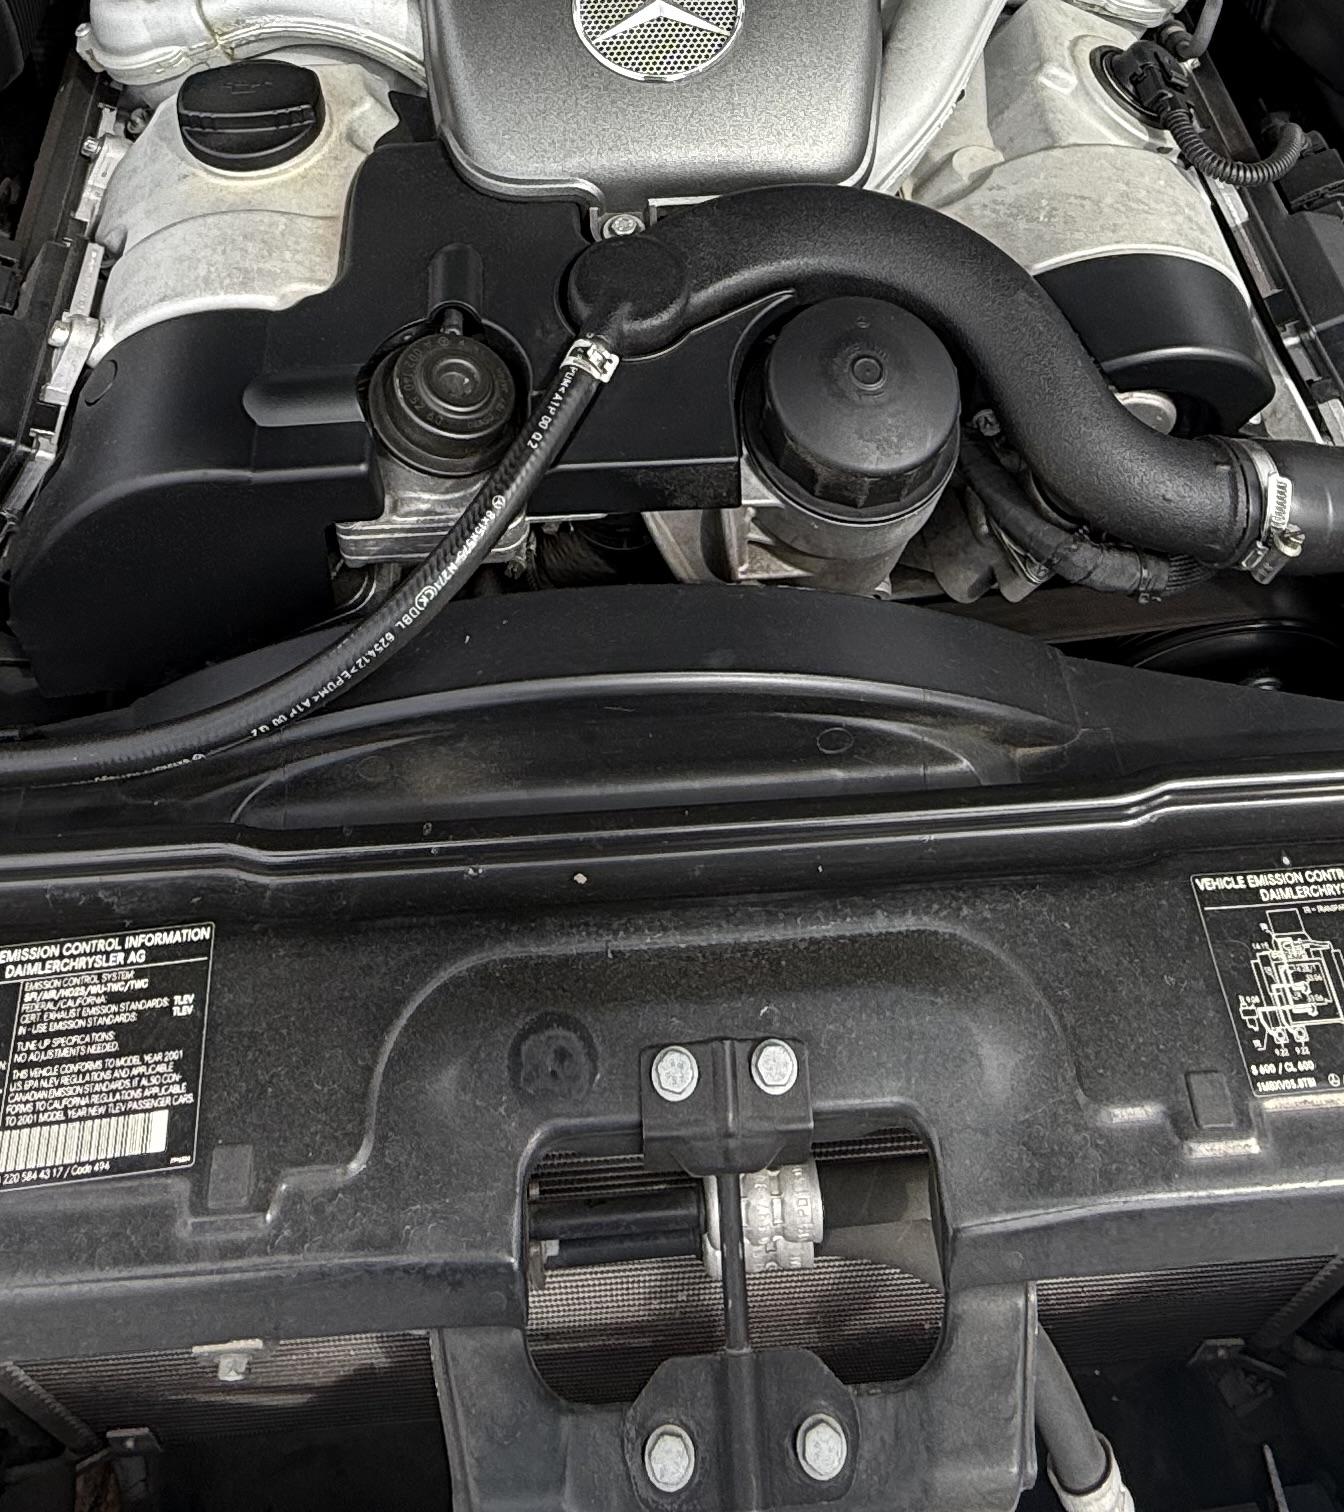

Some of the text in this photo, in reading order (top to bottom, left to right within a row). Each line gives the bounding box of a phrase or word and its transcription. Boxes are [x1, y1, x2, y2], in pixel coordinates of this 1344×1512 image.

[1194, 875, 1246, 891] VEHICLE
[1245, 871, 1304, 887] EMISSION
[62, 937, 122, 956] CONTROL
[124, 927, 210, 949] INFORMATION
[4, 949, 146, 977] DAIMLERCHRYSLER AG
[24, 978, 61, 990] EMISSION
[62, 974, 100, 986] CONTROL
[31, 1023, 47, 1033] USE
[48, 1018, 85, 1031] EMISSION
[172, 1005, 193, 1016] TLEV
[44, 1008, 79, 1020] EXHAUST
[82, 1003, 117, 1016] EMISSION
[173, 994, 194, 1005] TLEV
[12, 1049, 183, 1080] THIS VEHICLE CONFORMS TO MODEL YEAR 2001
[13, 1053, 26, 1063] NO
[28, 1045, 86, 1061] ADJUSTMENTS
[113, 1068, 129, 1078] AND
[4, 1116, 16, 1126] TO
[17, 1113, 37, 1125] 2001
[38, 1109, 65, 1122] MODEL
[67, 1107, 87, 1118] YEAR
[87, 1104, 105, 1115] NEW
[108, 1101, 126, 1113] TLEV
[126, 1096, 170, 1110] PASSENGER
[5, 1082, 186, 1115] FORMS TO CALIFORNIA REGULATIONS APPLICABLE
[2, 1173, 20, 1185] 220
[21, 1171, 37, 1182] 584
[38, 1169, 50, 1180] 43
[51, 1167, 62, 1178] 17
[70, 1163, 92, 1175] Code
